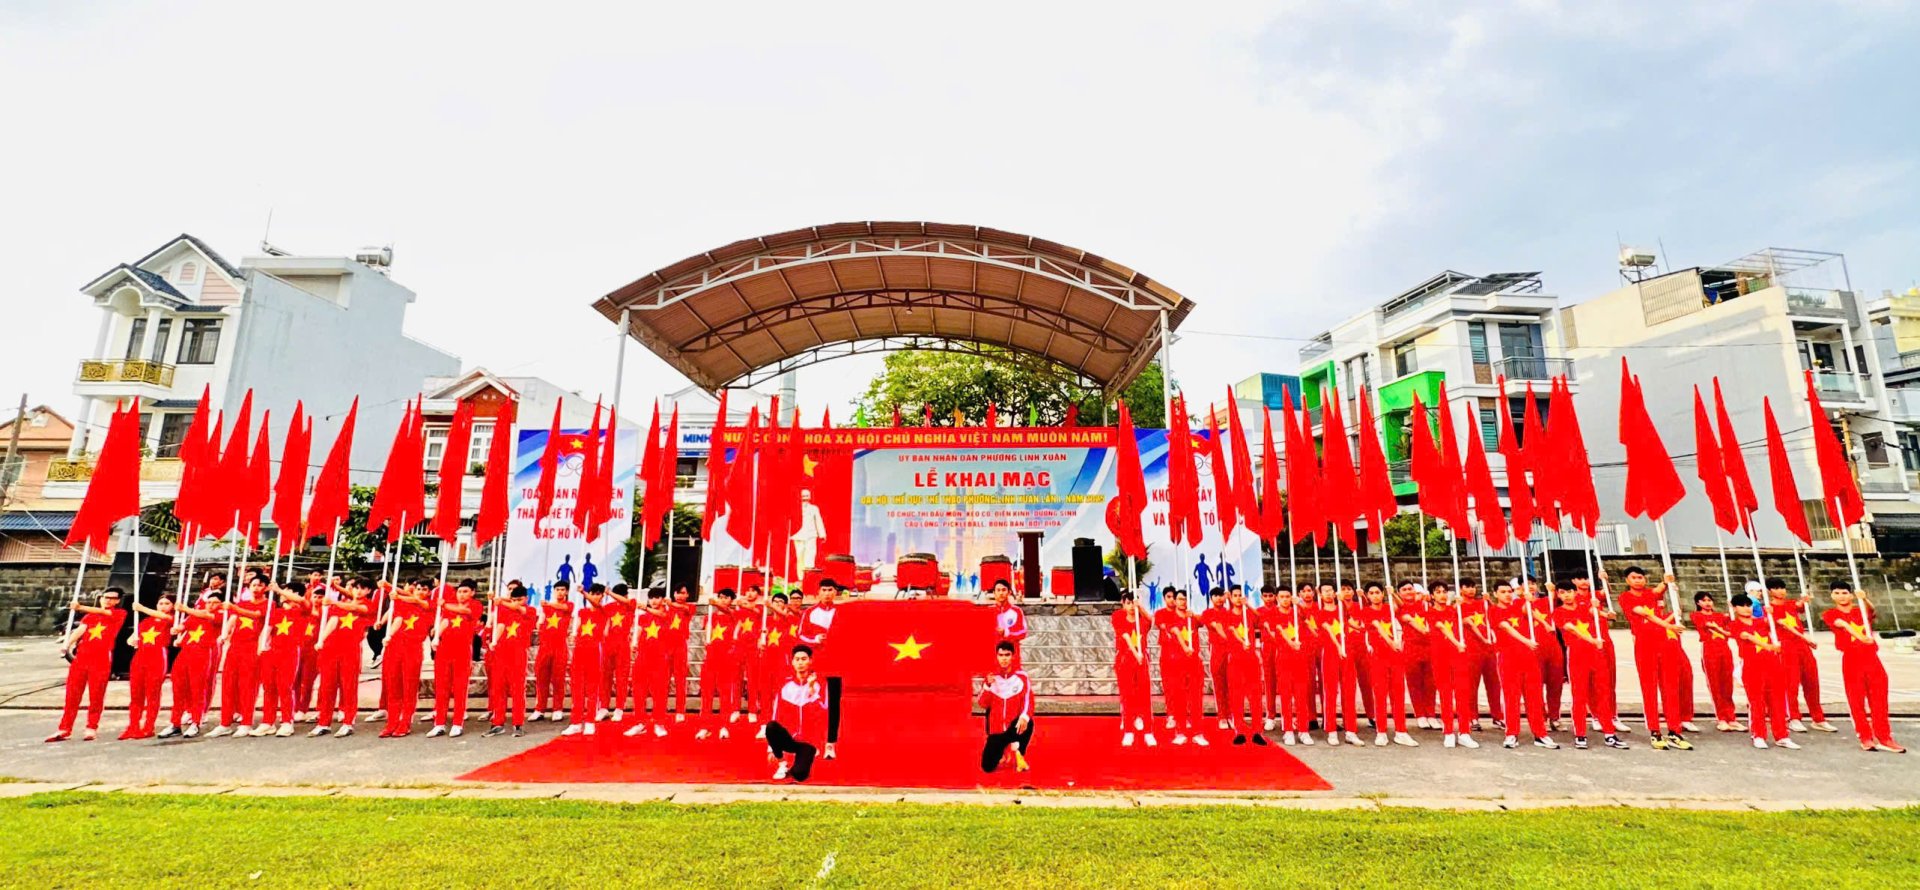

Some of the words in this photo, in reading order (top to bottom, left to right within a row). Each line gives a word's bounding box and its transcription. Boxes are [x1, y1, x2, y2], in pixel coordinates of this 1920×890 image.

[857, 432, 880, 445] HỘI
[883, 431, 911, 443] CHỦ
[914, 431, 956, 443] NGHĨA
[960, 431, 989, 446] VIỆT
[992, 432, 1023, 443] NAM
[1027, 431, 1068, 443] MUÔN
[913, 453, 930, 462] BAN
[1019, 453, 1040, 461] LINH
[915, 467, 938, 487] LỄ
[945, 472, 996, 487] KHAI
[1003, 471, 1051, 490] MẠC
[1152, 508, 1166, 526] VÀ
[1203, 507, 1216, 526] TỔ
